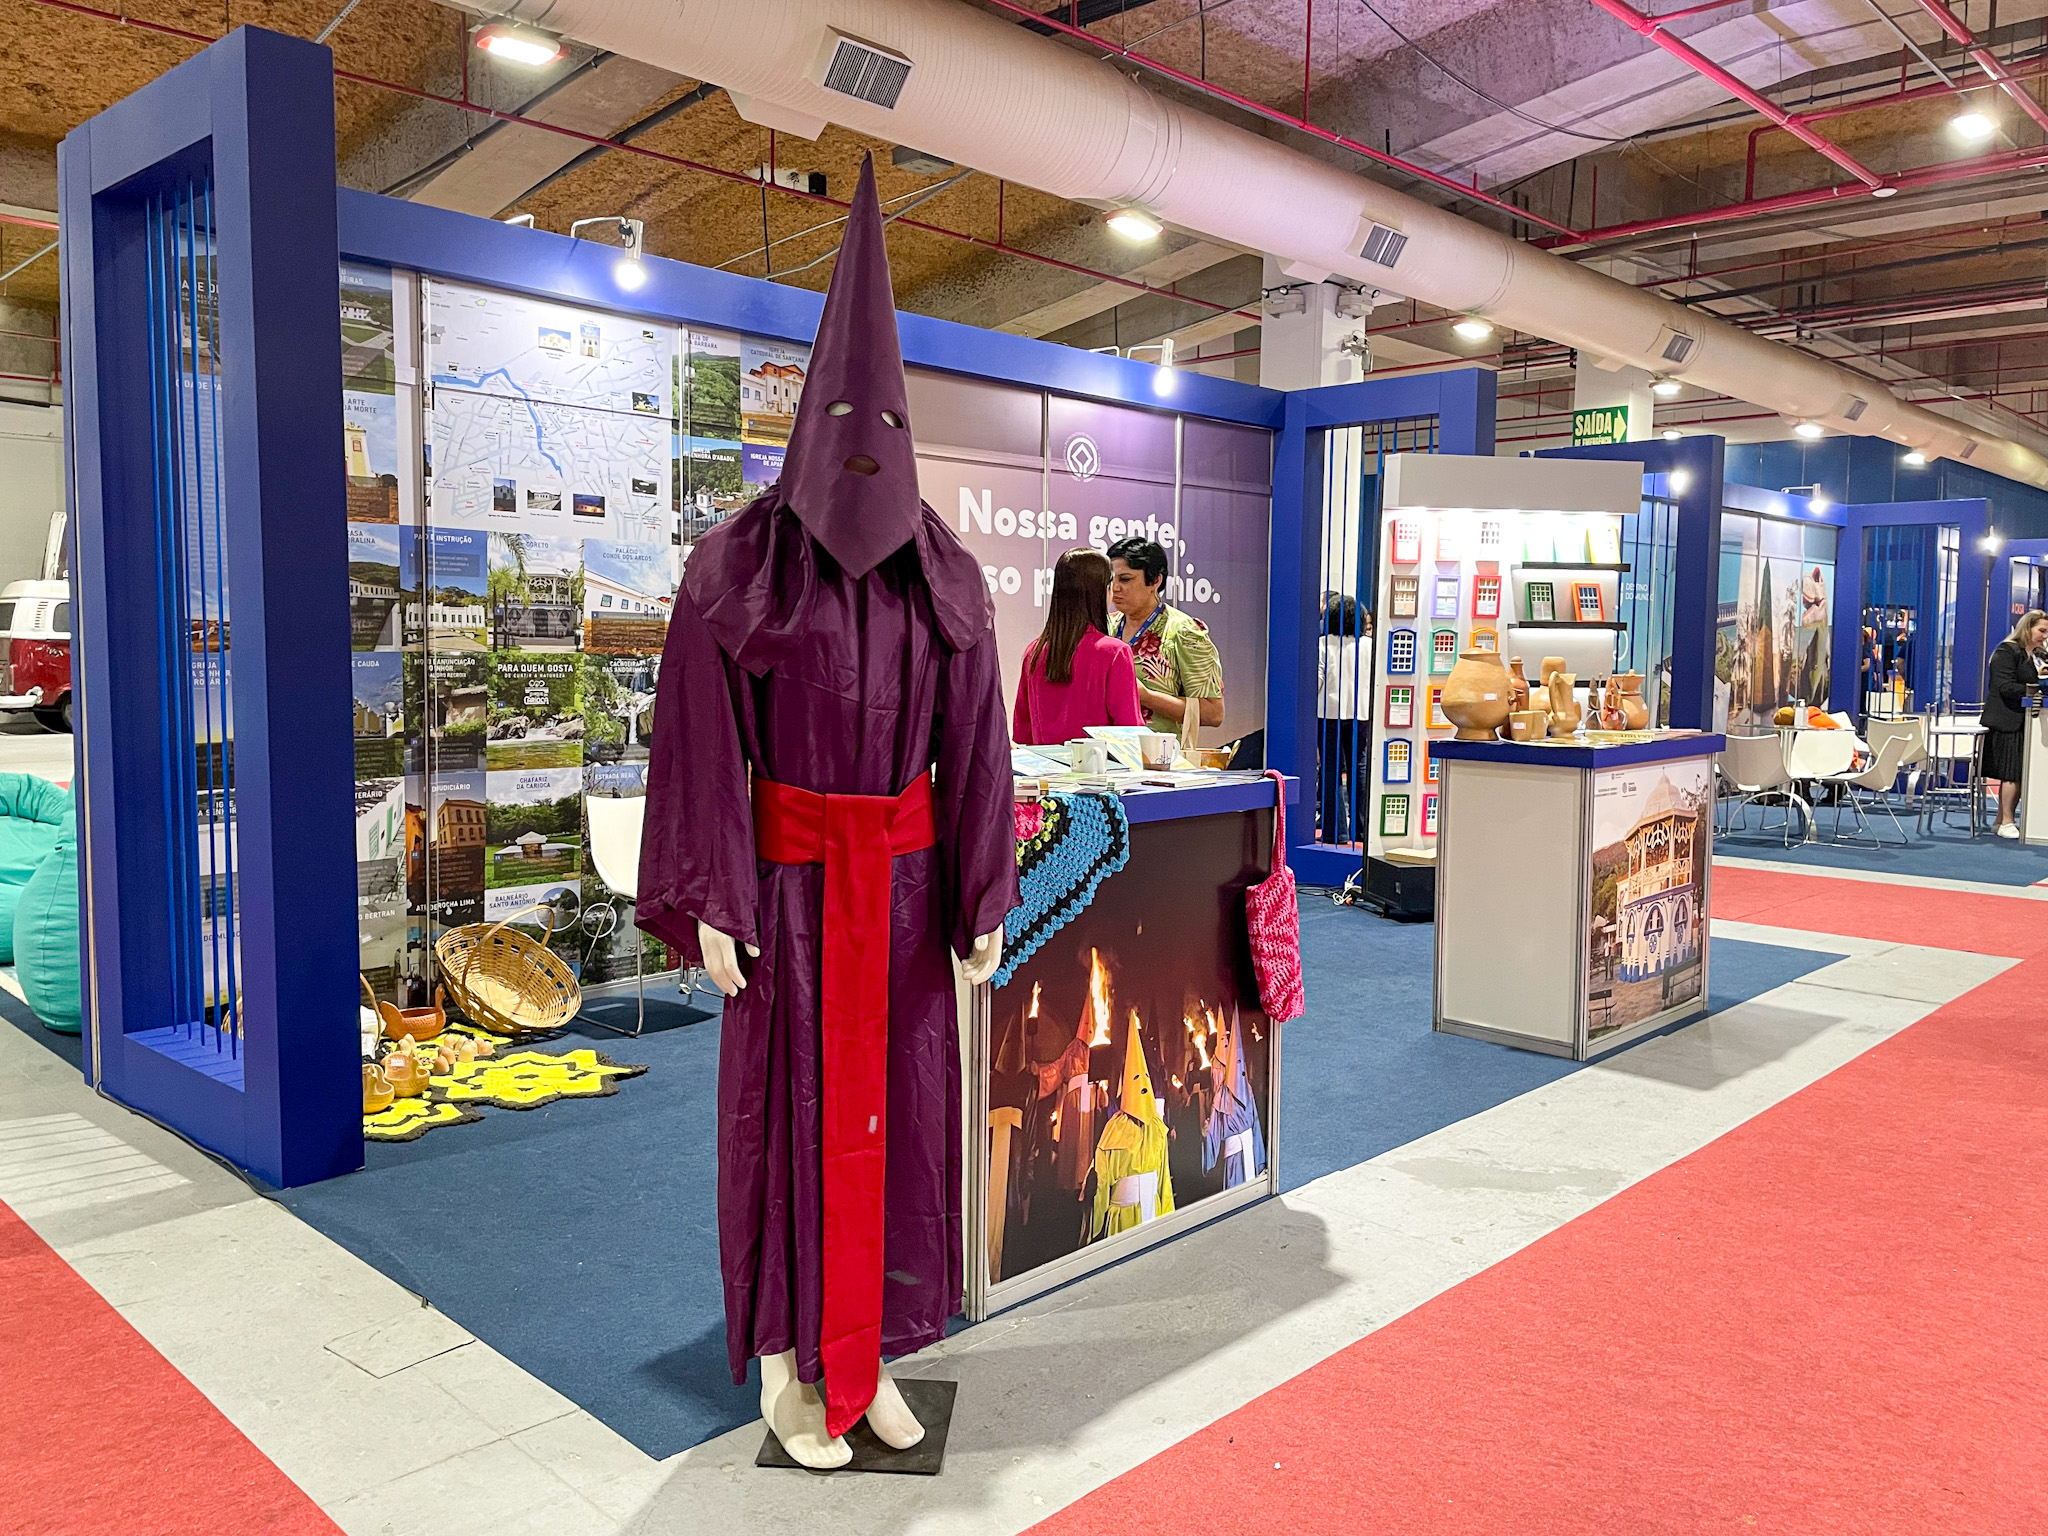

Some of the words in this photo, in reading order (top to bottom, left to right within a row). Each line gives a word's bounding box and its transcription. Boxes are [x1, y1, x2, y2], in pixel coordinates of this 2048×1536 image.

[347, 398, 365, 406] ARTE
[353, 406, 377, 414] MORTE
[1574, 411, 1612, 437] SAÍDA
[959, 487, 1077, 540] Nossa
[1088, 513, 1186, 558] gente,
[436, 534, 472, 544] INSTRUÇÃO
[615, 546, 638, 554] PALÁCIO
[603, 552, 620, 560] CONDE
[622, 553, 632, 561] DOS
[357, 660, 380, 668] CAUDA
[437, 657, 475, 667] ANUNCIAÇÃO
[497, 663, 519, 672] PARA
[521, 663, 544, 672] QUEM
[547, 663, 573, 672] GOSTA
[519, 776, 547, 784] CHAFARIZ
[516, 783, 524, 791] DA
[526, 782, 550, 790] CARIOCA
[495, 892, 528, 902] BALNEÁRIO
[438, 900, 458, 909] ROCHA
[460, 898, 475, 906] LIMA
[489, 901, 509, 909] SANTO
[510, 898, 535, 906] ANTÔNIO
[365, 909, 395, 919] BERTRAN
